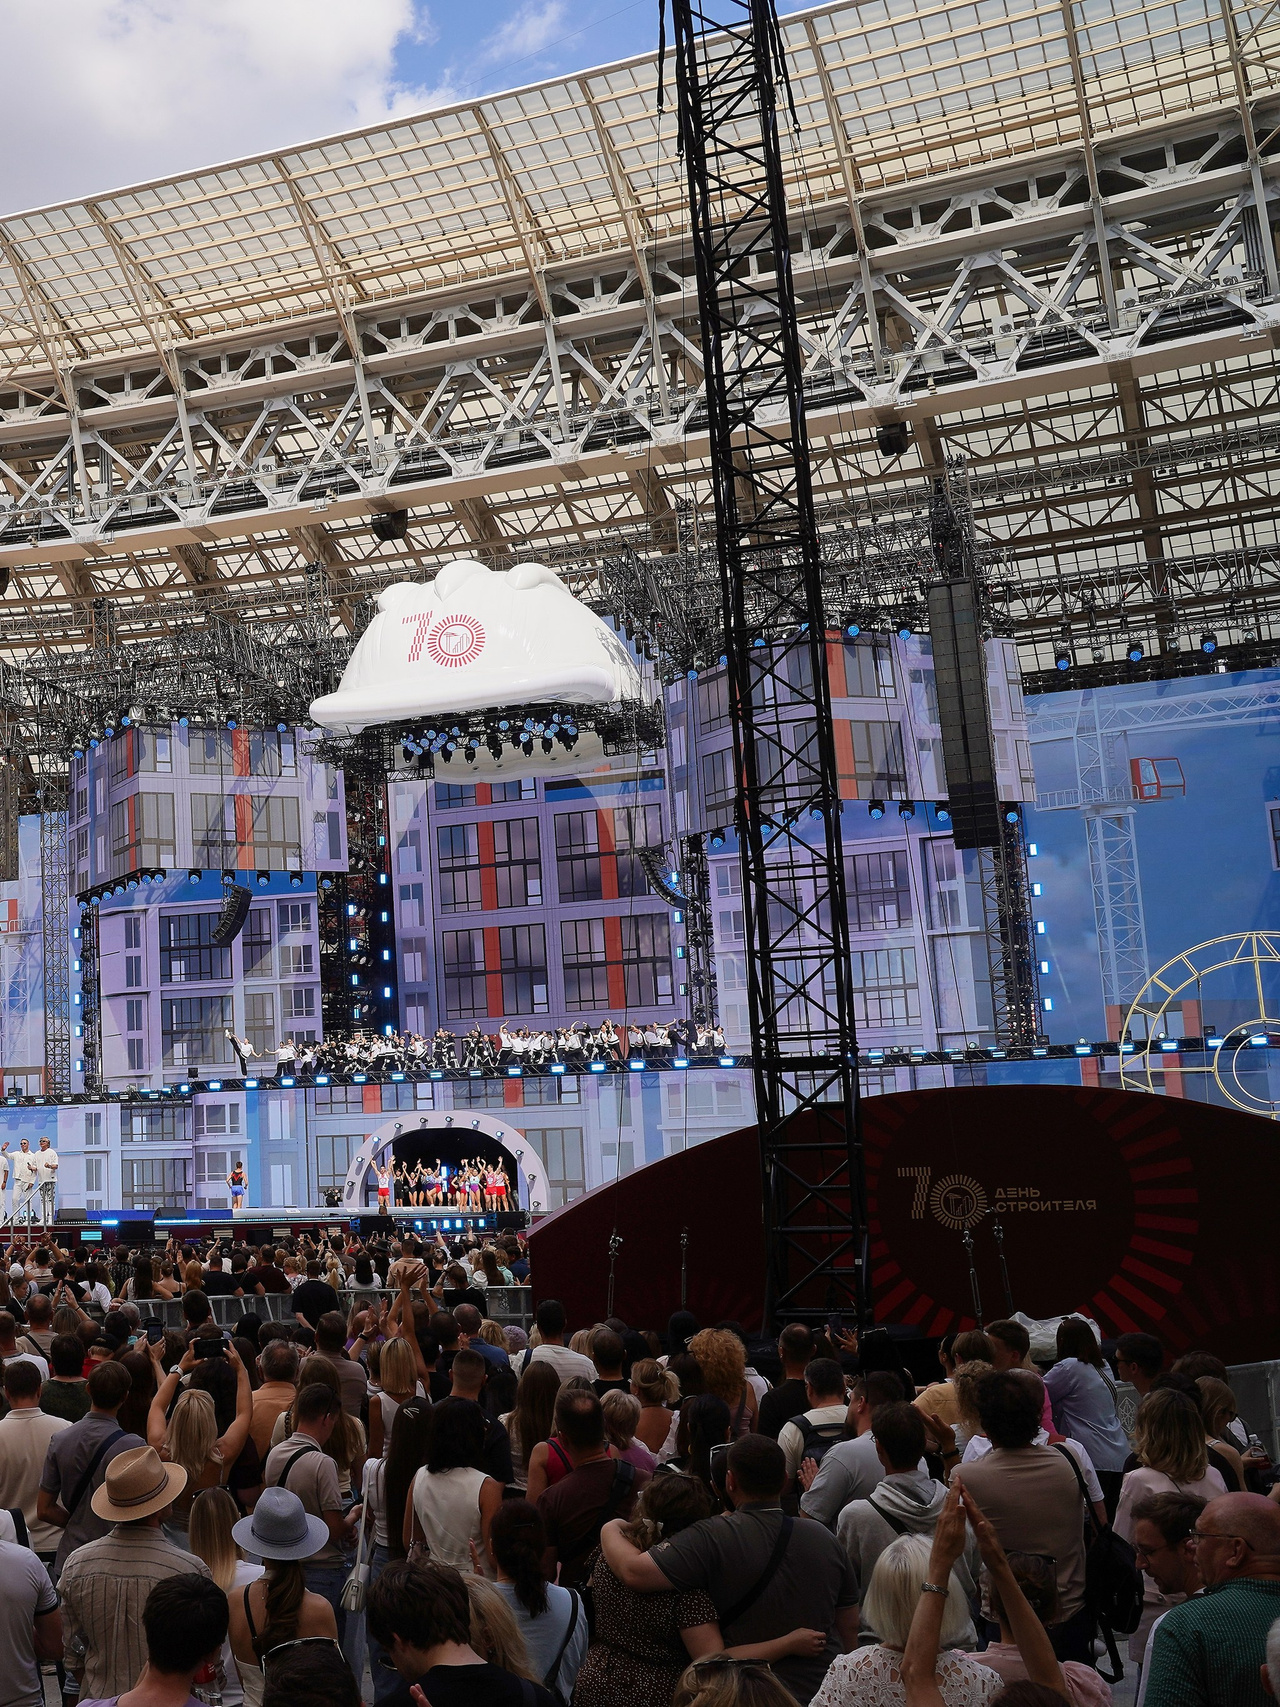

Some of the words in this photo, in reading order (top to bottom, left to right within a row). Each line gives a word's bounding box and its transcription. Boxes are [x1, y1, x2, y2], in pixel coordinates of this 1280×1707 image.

[402, 610, 485, 667] 70
[897, 1167, 987, 1229] 70
[995, 1187, 1040, 1198] ДЕНЬ
[996, 1200, 1097, 1212] СТРОИТЕЛЯ
